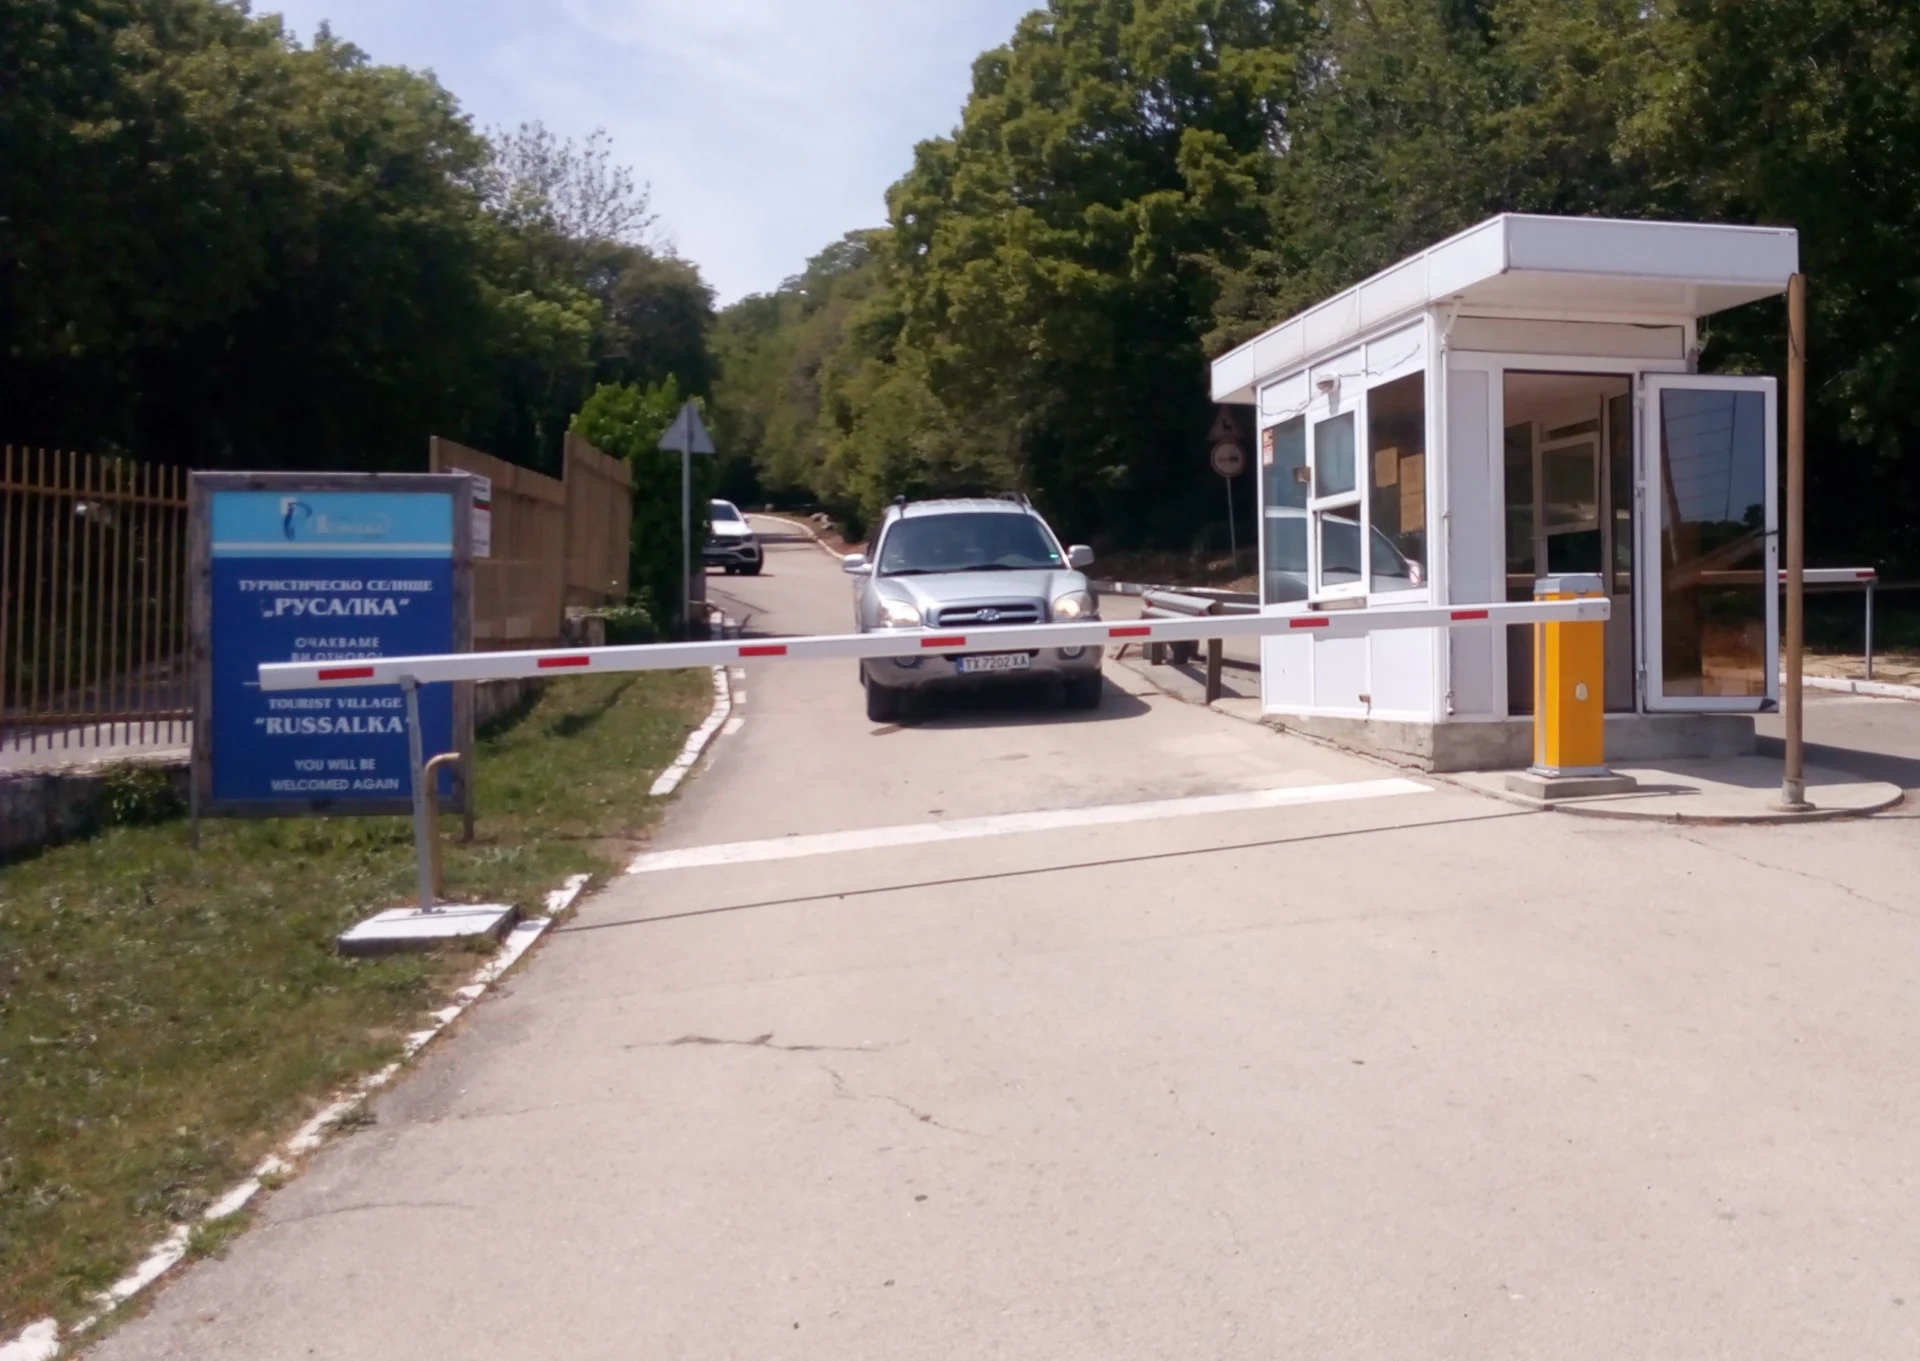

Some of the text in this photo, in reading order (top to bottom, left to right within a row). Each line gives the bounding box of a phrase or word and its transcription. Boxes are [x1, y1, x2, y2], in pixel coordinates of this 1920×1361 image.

[239, 580, 362, 591] ТУРИСТИЧЕСКО
[295, 637, 380, 648] ОЧАКВАМЕ
[983, 656, 1010, 669] 7202
[269, 698, 402, 709] TOURIST VILLAGE
[295, 759, 376, 771] YOU WILL BE
[271, 778, 400, 791] WELCOMED AGAIN
